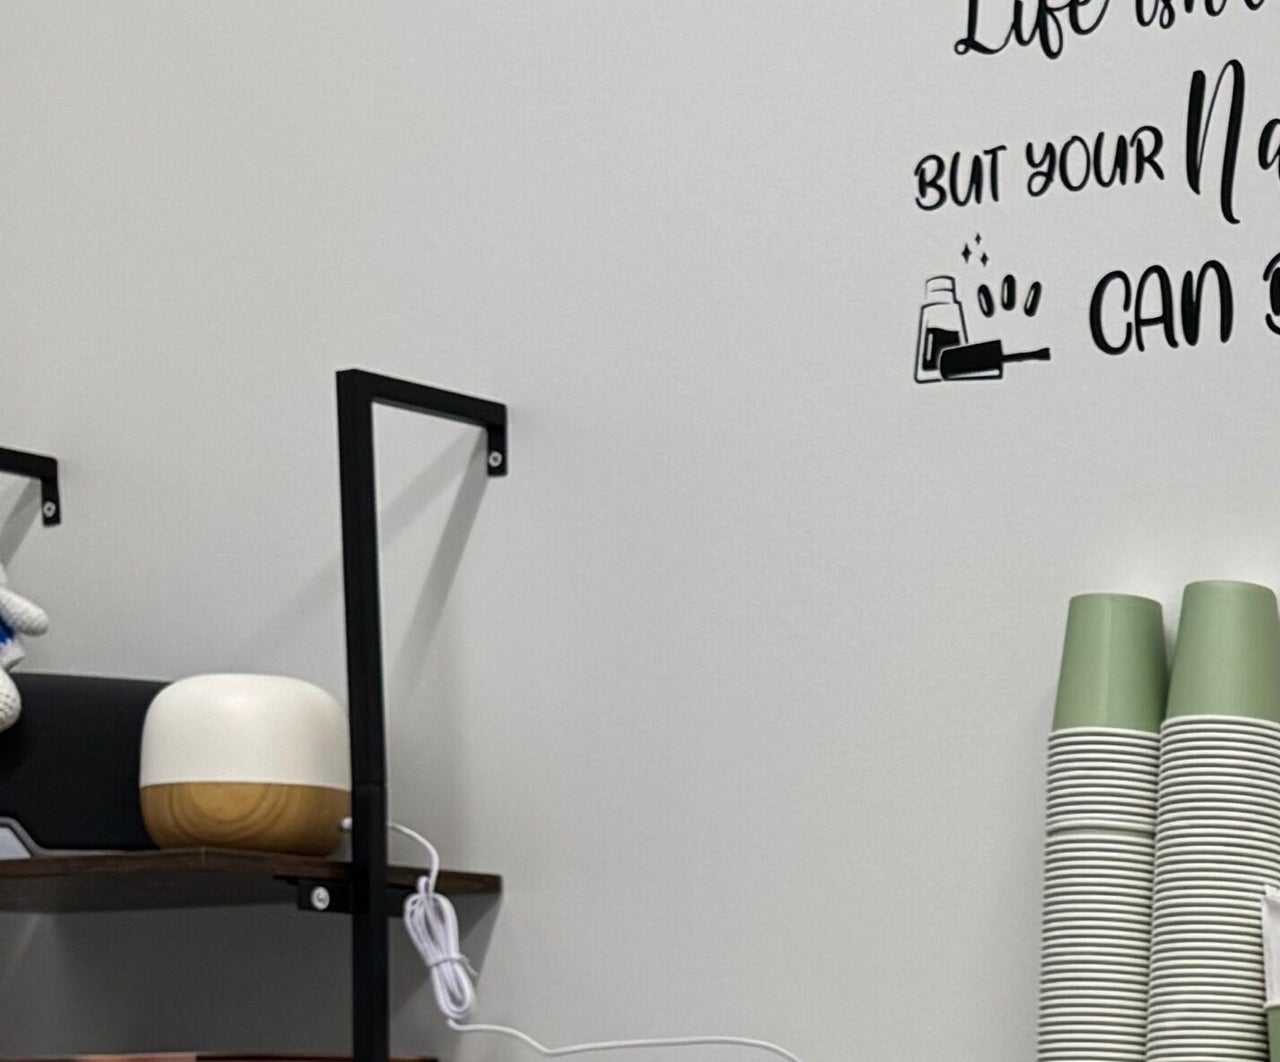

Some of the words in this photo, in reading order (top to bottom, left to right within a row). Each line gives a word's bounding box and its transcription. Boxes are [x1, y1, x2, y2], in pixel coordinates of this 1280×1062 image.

[914, 145, 1006, 210] BUT
[1026, 125, 1165, 197] YOUR
[1089, 260, 1233, 355] CAN
